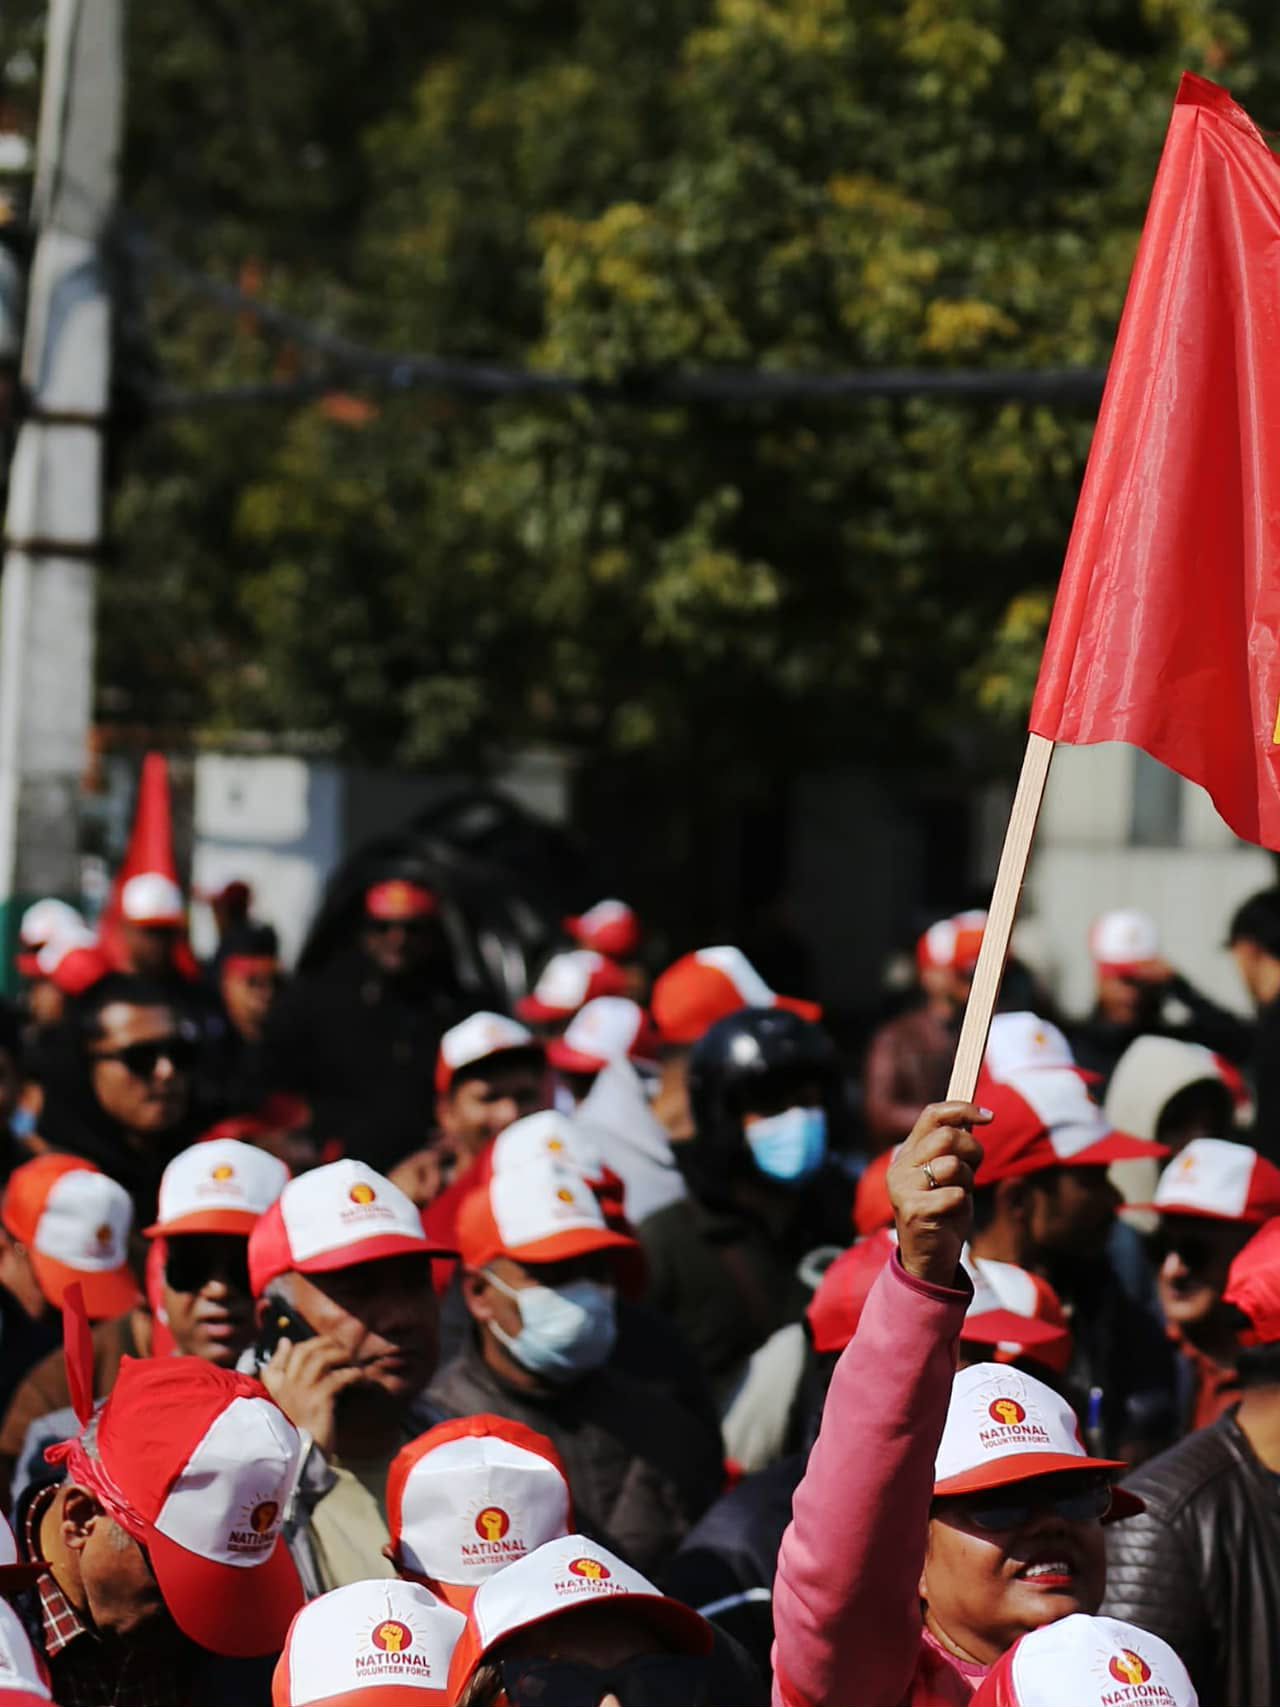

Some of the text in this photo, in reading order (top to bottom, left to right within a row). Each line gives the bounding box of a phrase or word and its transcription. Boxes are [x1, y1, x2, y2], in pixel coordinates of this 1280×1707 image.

[979, 1424, 1048, 1441] NATIONAL
[983, 1435, 1026, 1449] VOLUNTEER
[461, 1539, 528, 1555] NATIONAL
[355, 1652, 431, 1669] NATIONAL
[356, 1666, 432, 1678] VOLUNTEER FORCE
[1101, 1684, 1175, 1706] NATIONAL
